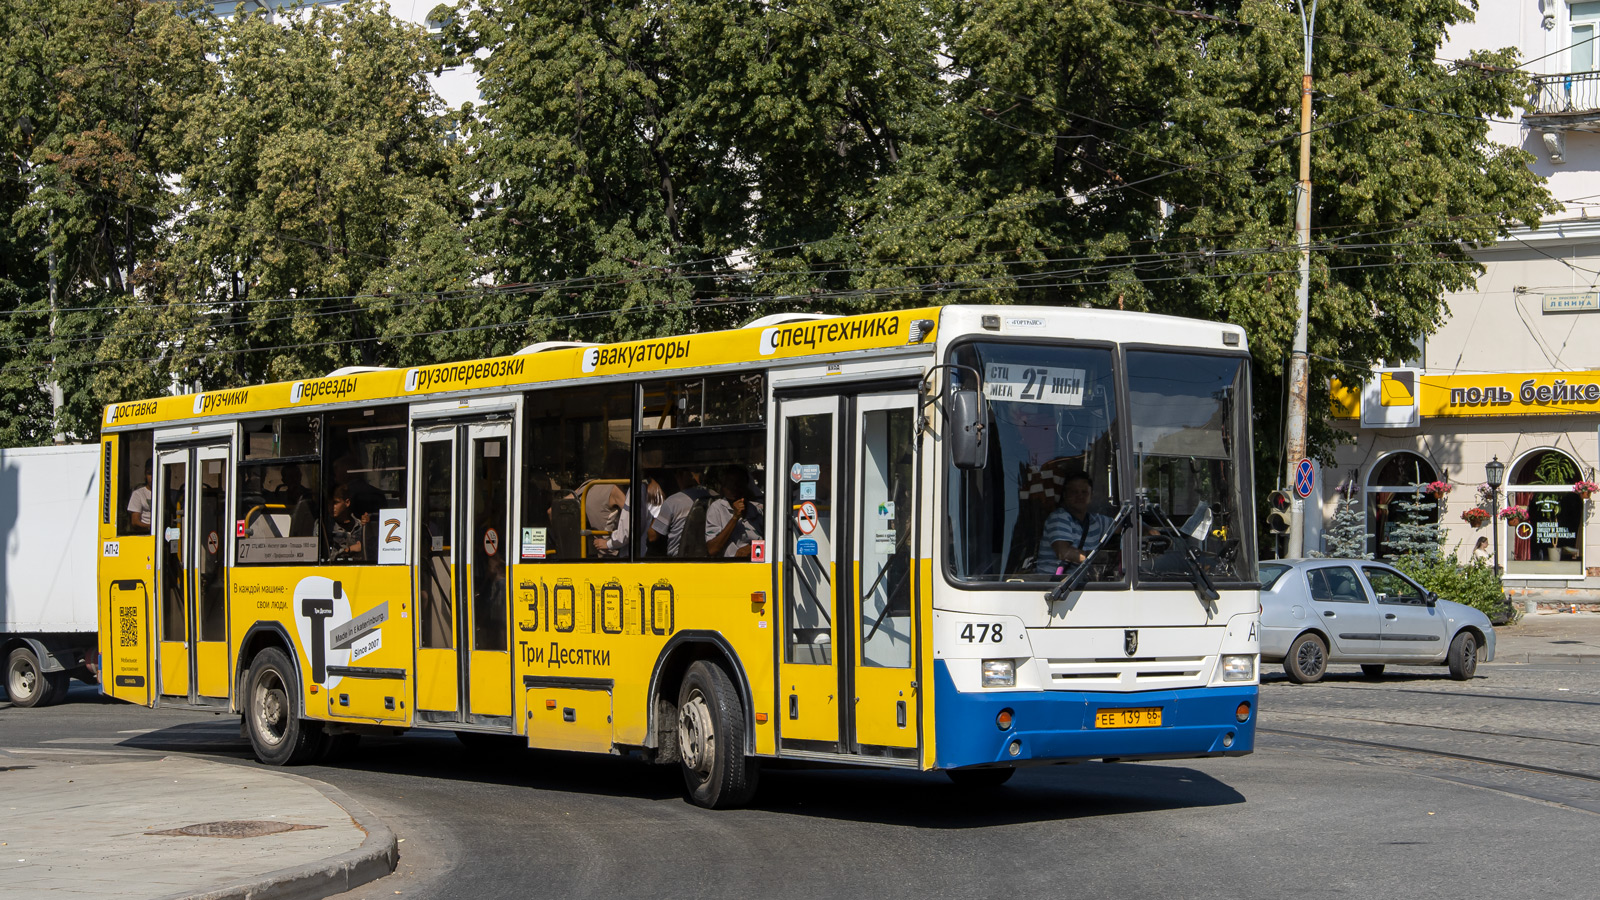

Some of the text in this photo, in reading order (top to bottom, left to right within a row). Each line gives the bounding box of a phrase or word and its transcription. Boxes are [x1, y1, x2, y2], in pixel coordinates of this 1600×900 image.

[771, 315, 900, 349] спецтехника
[591, 340, 690, 369] эвакуаторы
[412, 358, 525, 389] грузоперевозки
[991, 366, 1009, 381] СТЦ
[297, 378, 358, 401] переезды
[990, 384, 1013, 397] МЕГА
[1020, 368, 1080, 400] 27 ЖБИ
[199, 390, 249, 411] грузчики
[1450, 386, 1514, 405] поль
[111, 401, 158, 422] доставка
[105, 544, 119, 555] АП-2
[239, 544, 251, 558] 27
[233, 583, 238, 593] В
[238, 583, 261, 595] каждой
[261, 584, 285, 594] машине
[257, 600, 288, 611] свои люди.
[335, 630, 348, 643] Made
[960, 623, 1003, 643] 478
[354, 638, 380, 657] Since 2007
[519, 640, 611, 668] Три Десятки
[1121, 711, 1140, 725] 139
[1147, 708, 1158, 719] 66
